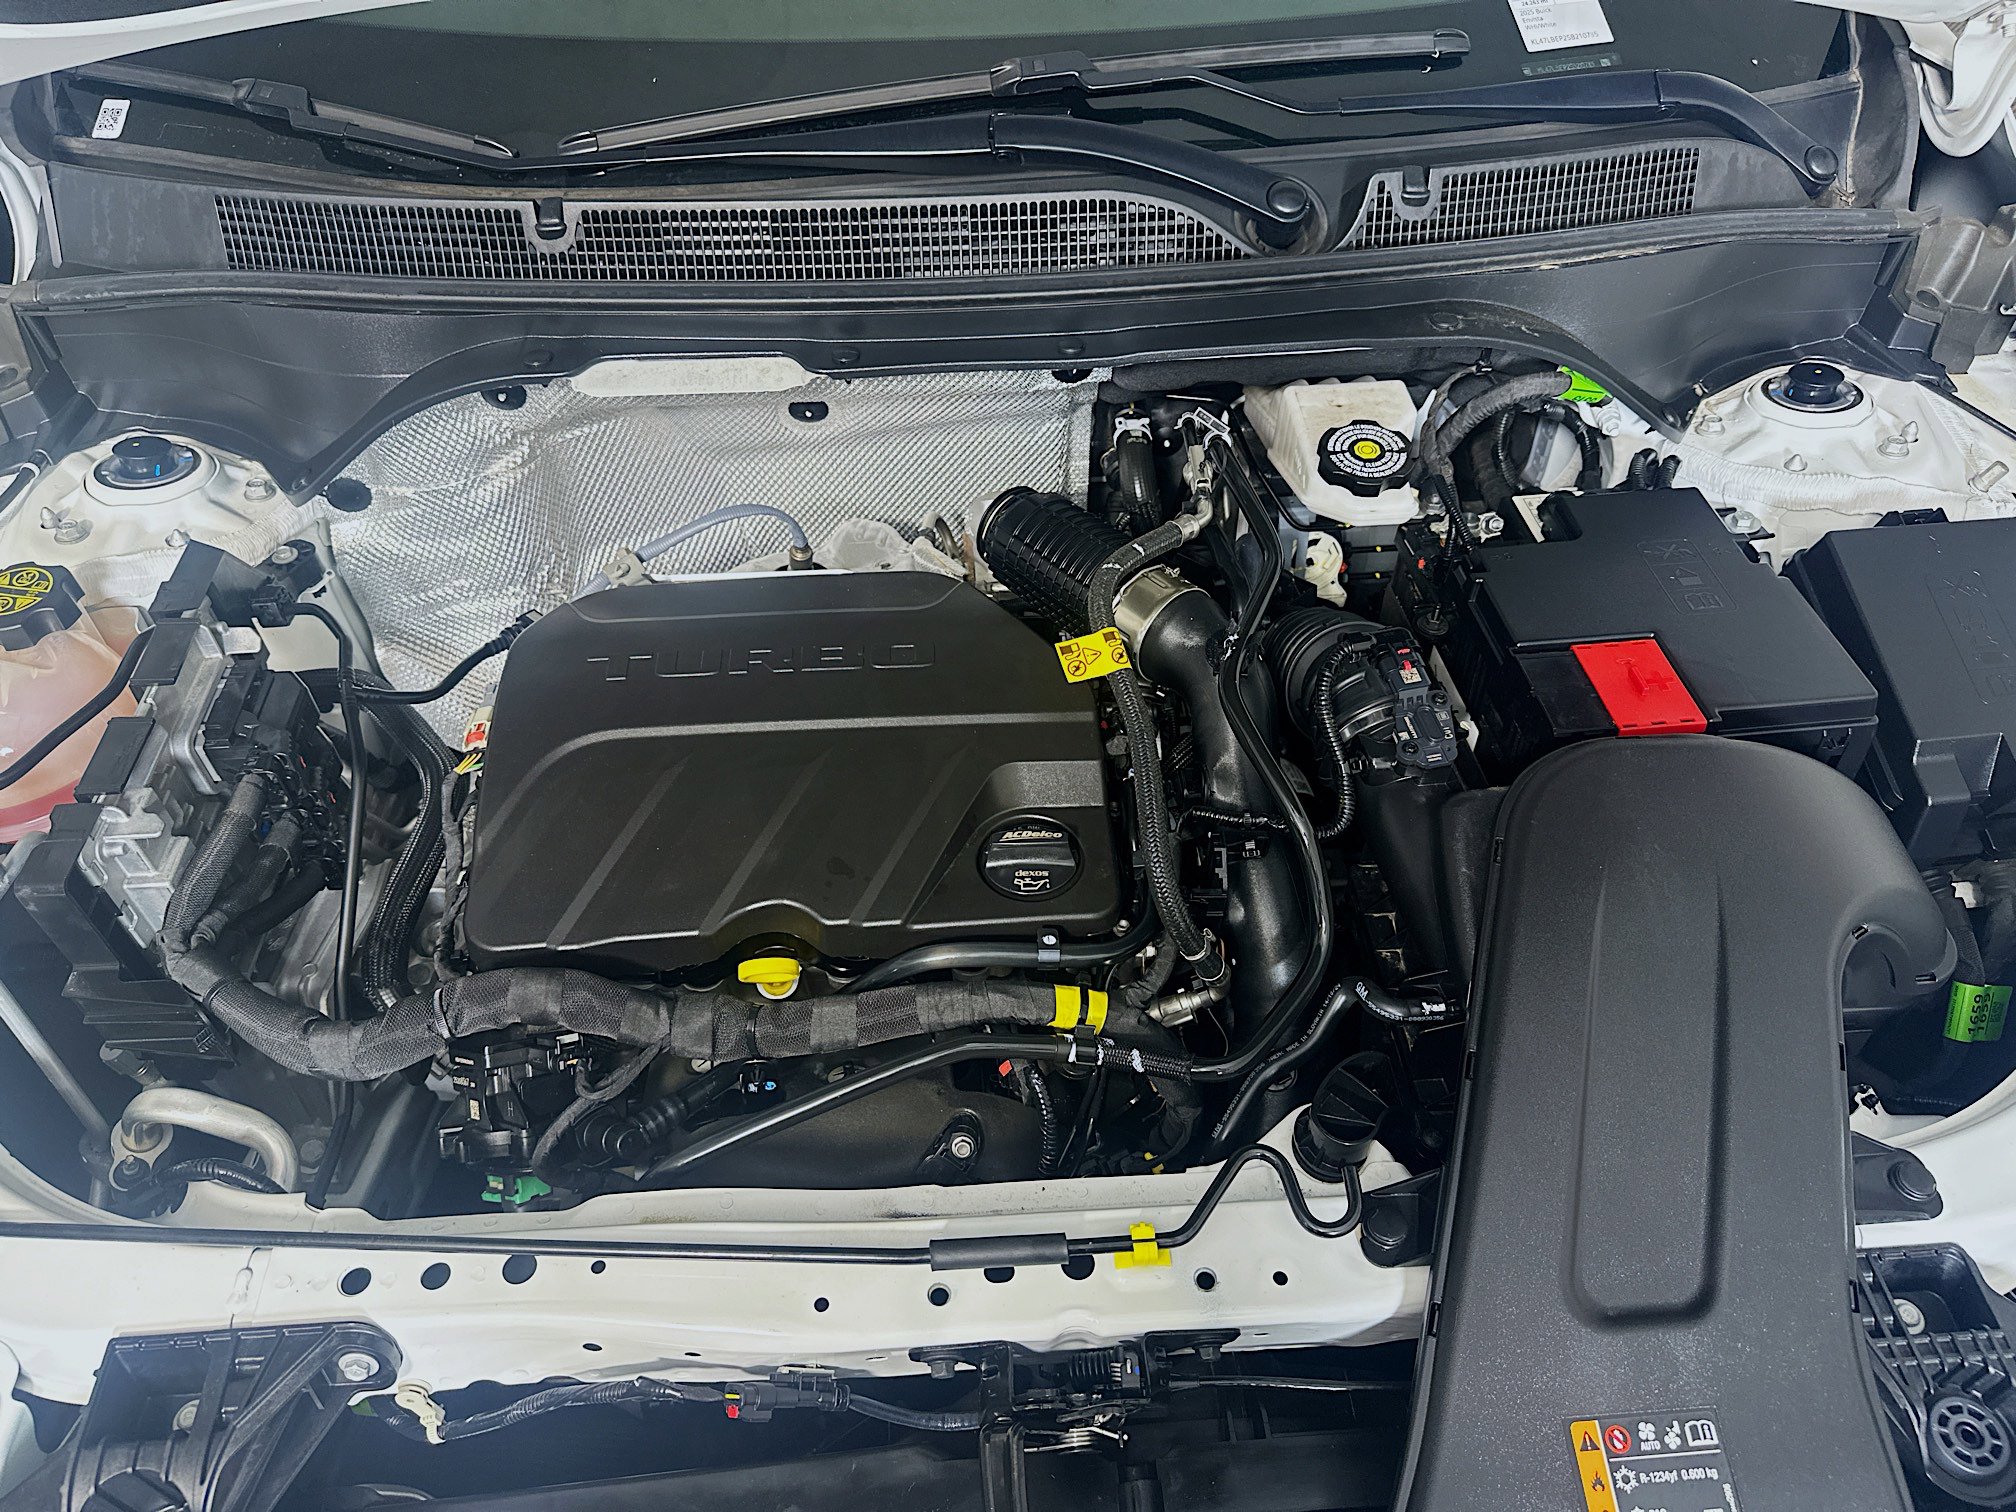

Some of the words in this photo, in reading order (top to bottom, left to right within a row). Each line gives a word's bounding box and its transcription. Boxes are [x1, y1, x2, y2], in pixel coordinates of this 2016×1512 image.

[1520, 8, 1536, 16] 2025
[1535, 7, 1552, 15] Buick
[586, 642, 936, 682] TURBO
[1000, 830, 1063, 841] ACDelco
[1014, 869, 1050, 877] dexos
[1967, 993, 1984, 1035] 1659
[1285, 1041, 1301, 1054] MADE
[1640, 1440, 1661, 1451] AUTO
[1639, 1468, 1678, 1484] R-1234yf
[1681, 1468, 1706, 1481] 0.600
[1705, 1467, 1719, 1480] kg
